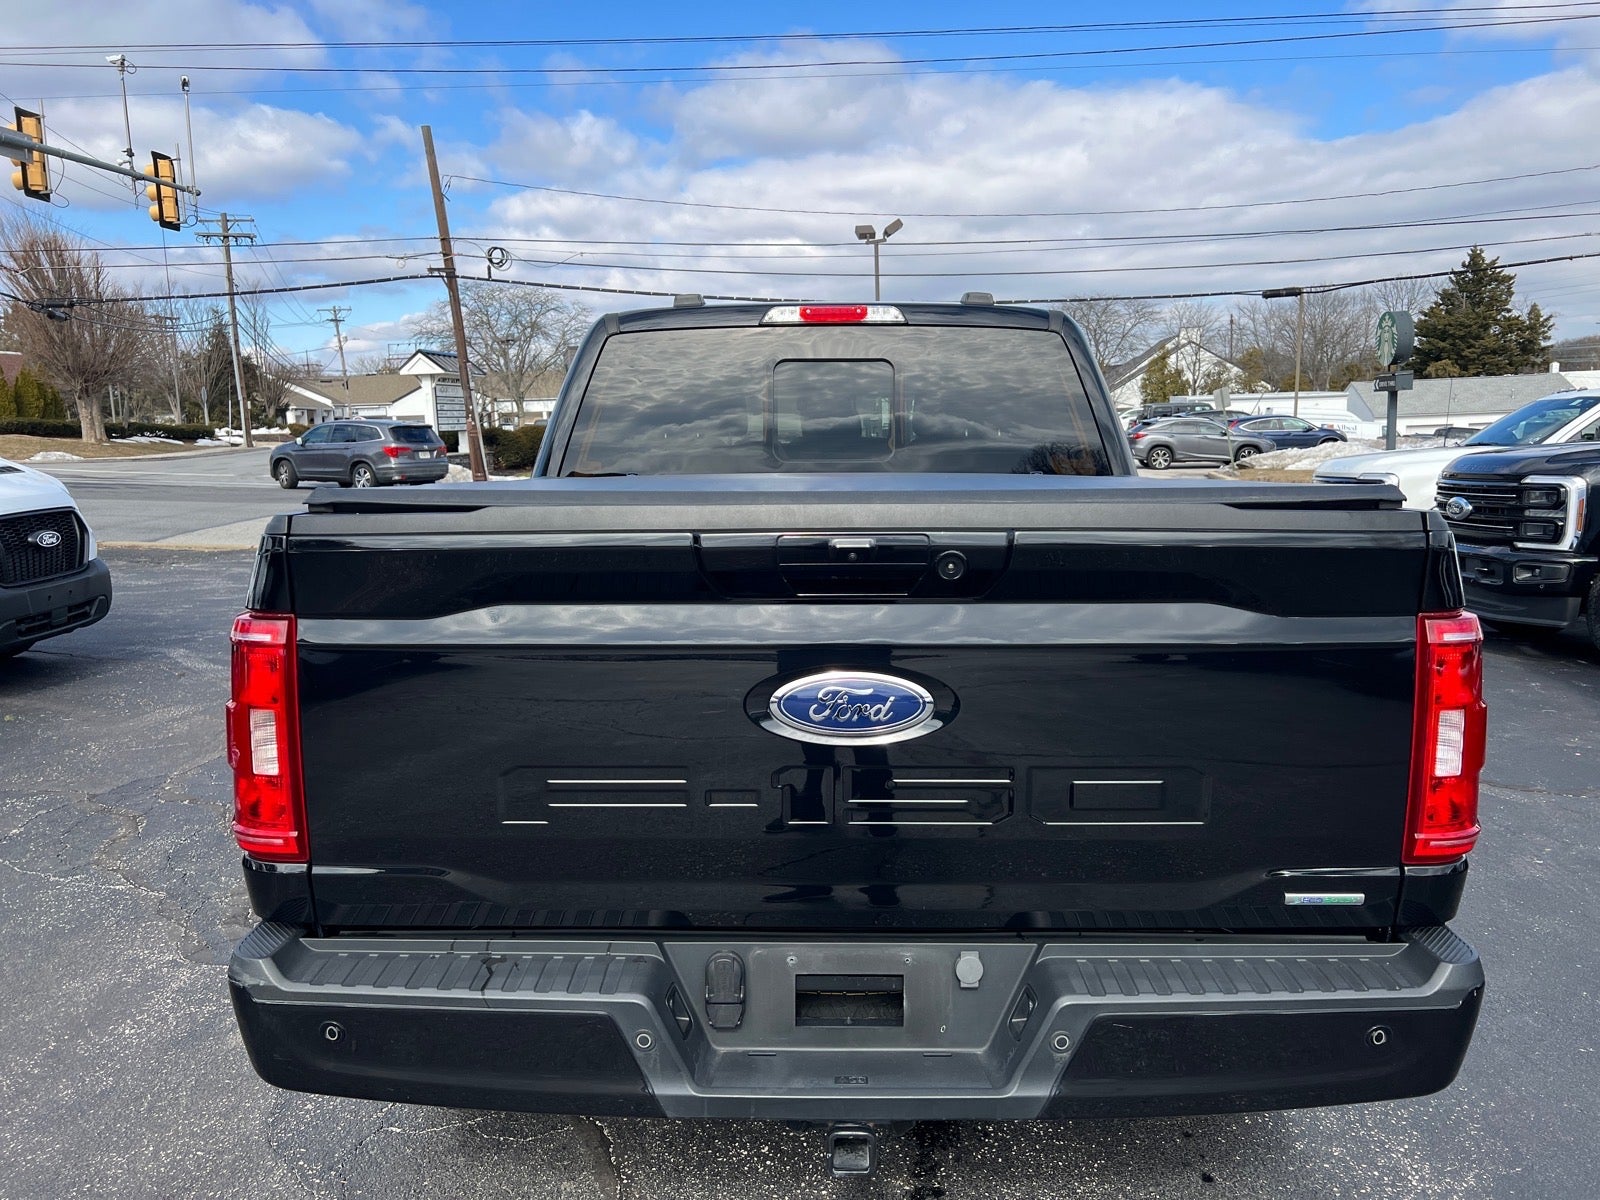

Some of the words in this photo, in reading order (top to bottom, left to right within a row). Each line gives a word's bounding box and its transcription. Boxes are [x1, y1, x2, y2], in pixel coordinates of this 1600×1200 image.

[42, 533, 57, 545] Ford
[808, 686, 896, 722] Ford
[498, 765, 1212, 827] F-150
